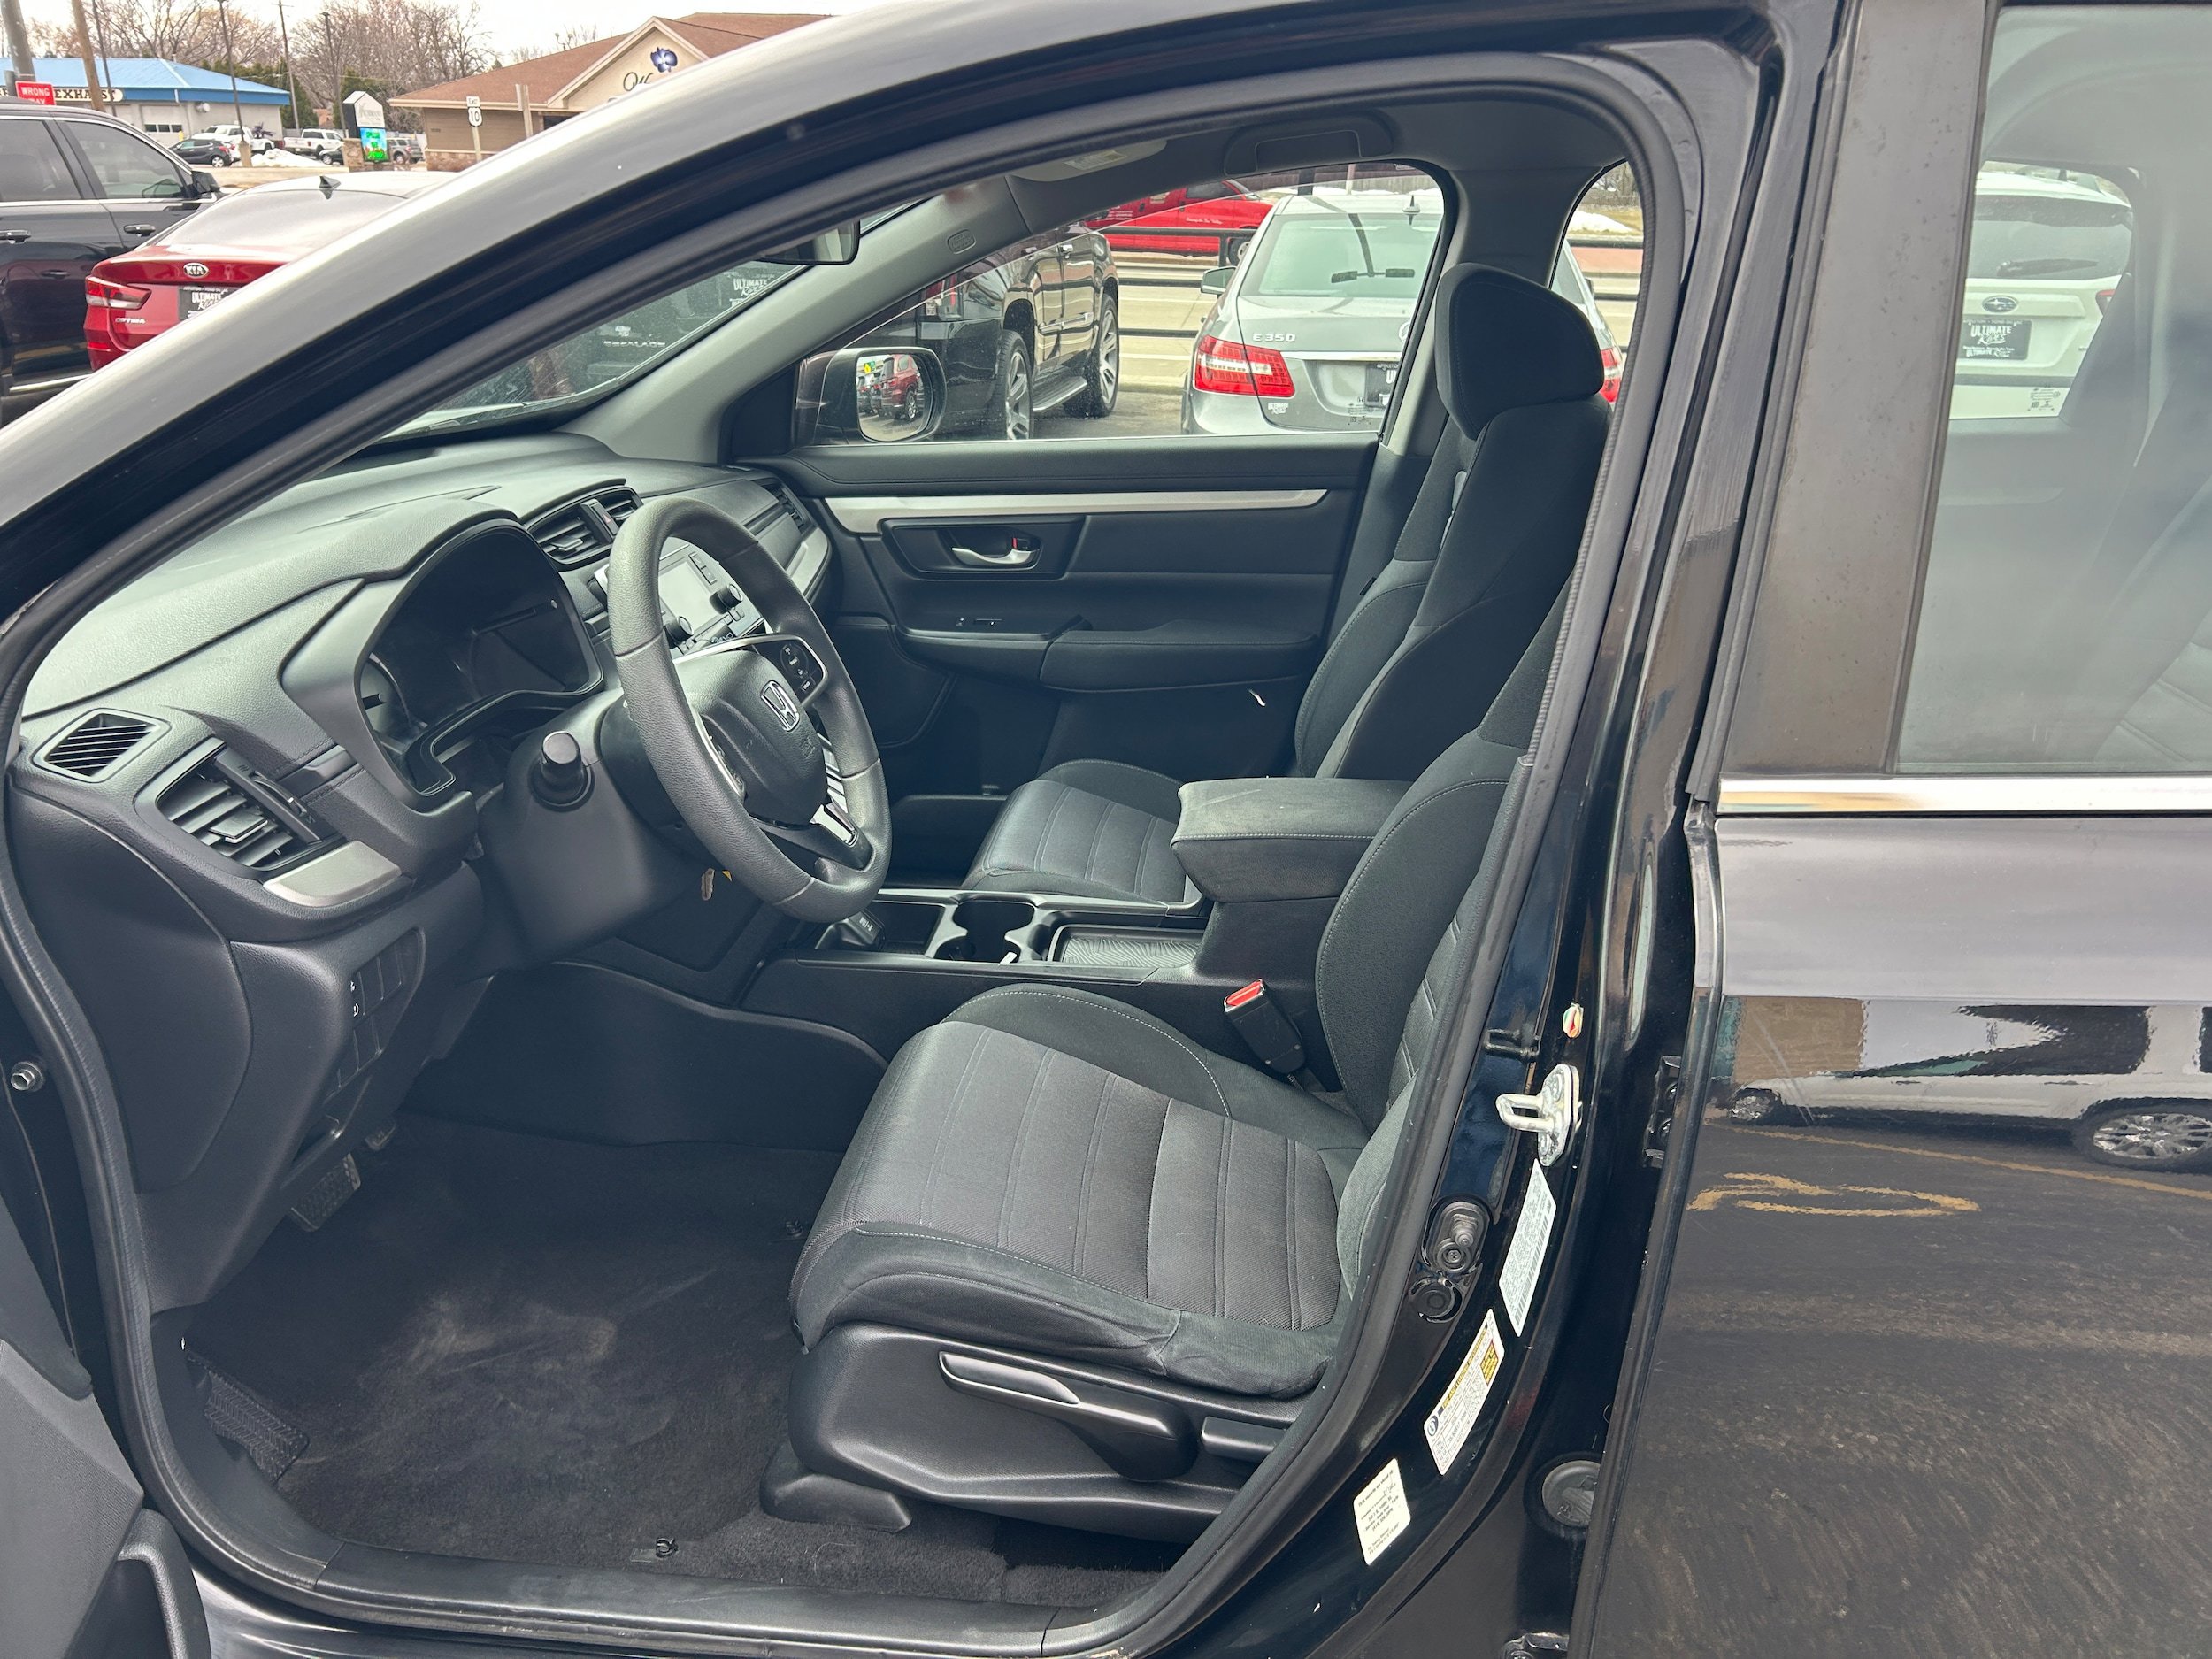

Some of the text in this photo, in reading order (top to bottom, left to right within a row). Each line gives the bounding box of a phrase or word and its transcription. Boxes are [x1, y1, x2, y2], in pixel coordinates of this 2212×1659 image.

[20, 87, 50, 96] WRONG
[471, 111, 480, 122] 10
[185, 265, 204, 276] KIA
[733, 278, 768, 291] ULTIMATE
[1970, 325, 2012, 337] ULTIMATE
[1252, 333, 1296, 342] E 350
